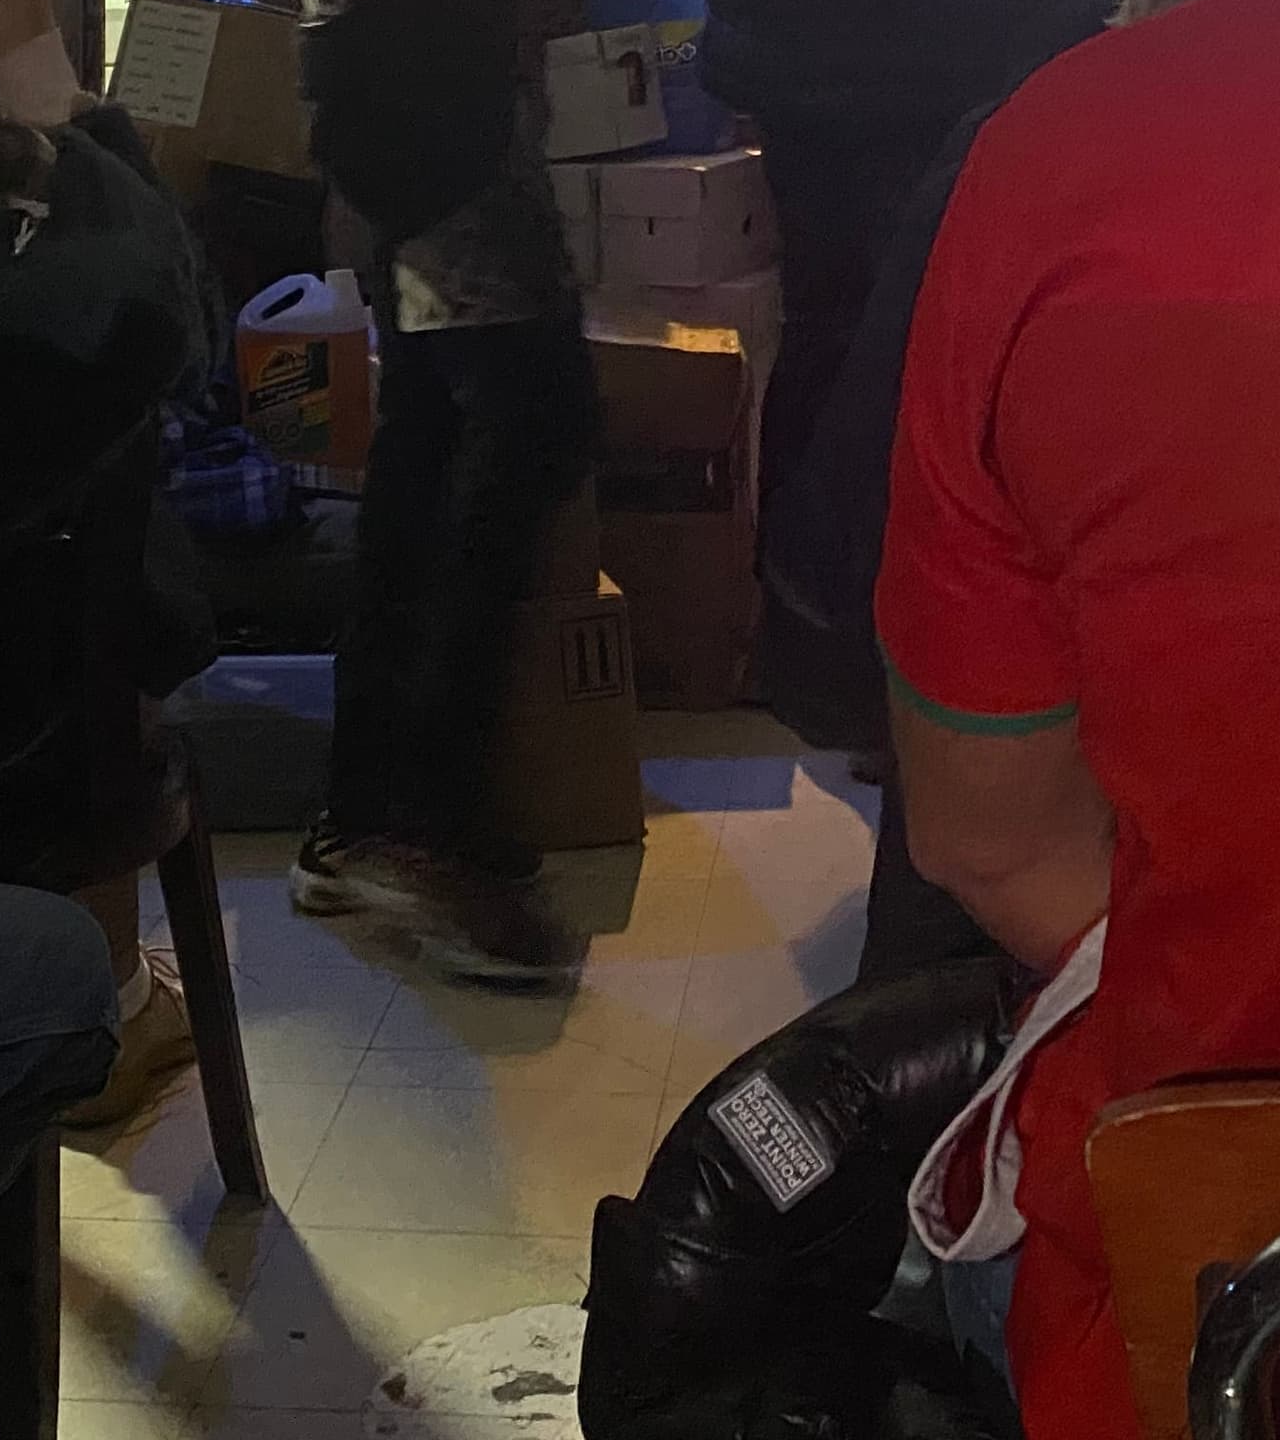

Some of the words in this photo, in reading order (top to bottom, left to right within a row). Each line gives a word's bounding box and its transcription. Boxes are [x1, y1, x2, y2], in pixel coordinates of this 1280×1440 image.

[729, 1095, 769, 1142] ZERO
[742, 1089, 775, 1127] TECH
[759, 1136, 804, 1190] POINT
[767, 1121, 813, 1179] WINTER
